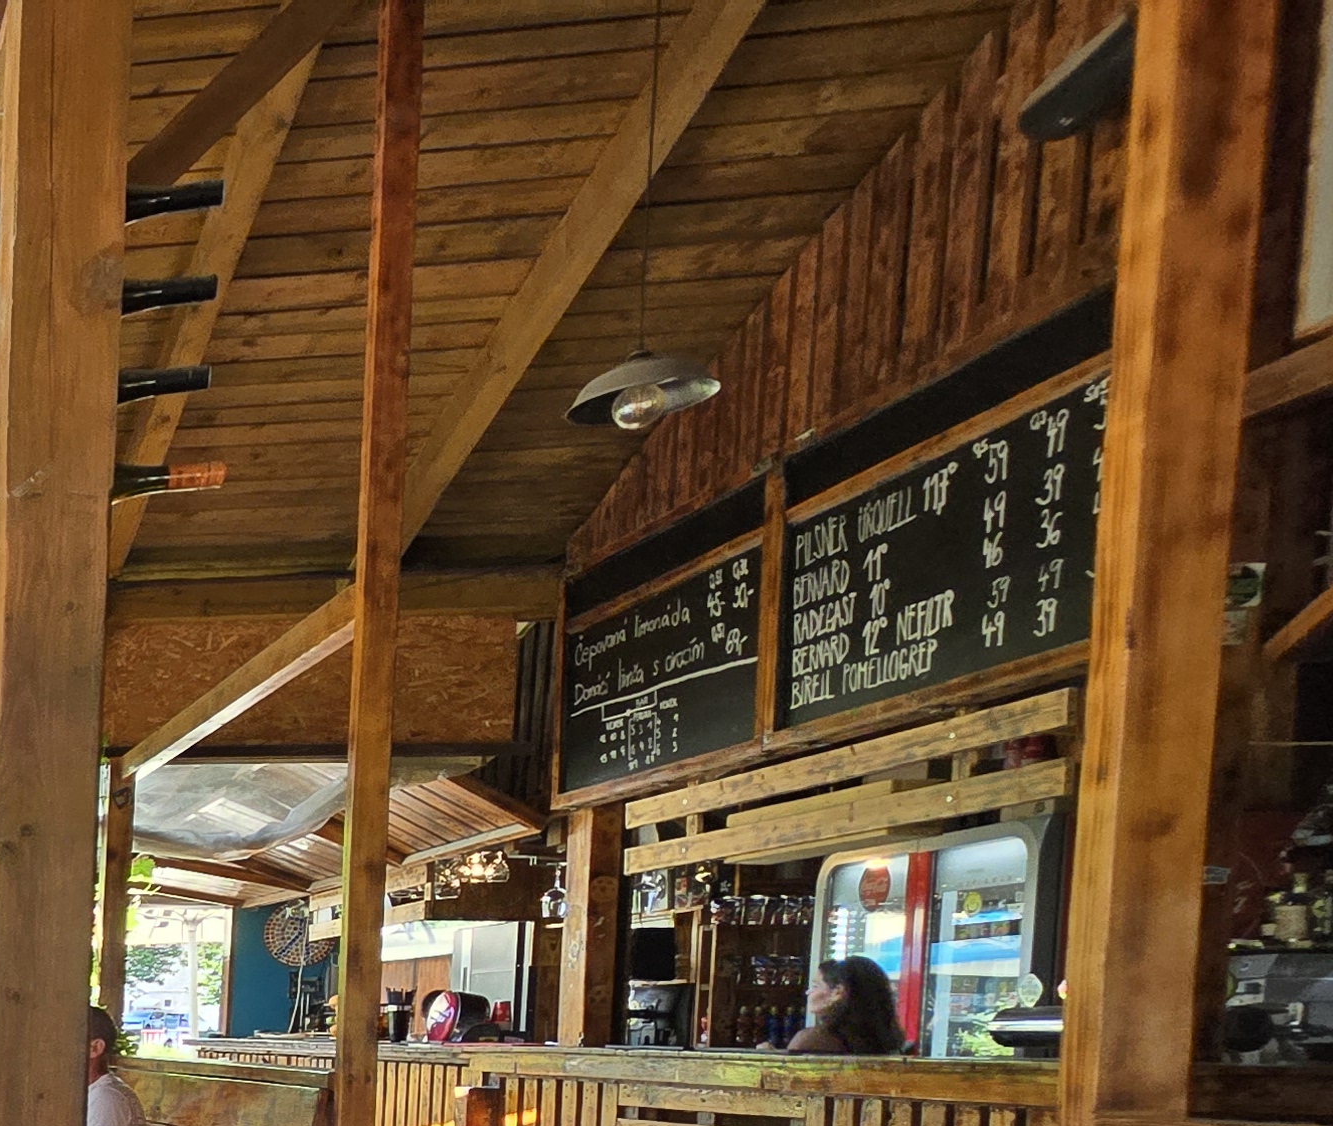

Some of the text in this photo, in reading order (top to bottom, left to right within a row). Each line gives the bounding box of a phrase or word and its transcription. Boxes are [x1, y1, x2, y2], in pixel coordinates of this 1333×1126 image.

[793, 559, 850, 611] BERNARD
[983, 490, 1007, 534] 49
[1034, 463, 1065, 506] 39
[795, 514, 849, 570] PILSNER
[984, 439, 1008, 484] 59
[1046, 408, 1069, 458] 49
[792, 632, 850, 678] BERNARD
[862, 616, 889, 657] 12°
[986, 575, 1012, 608] 59
[1037, 558, 1064, 592] 49
[793, 591, 858, 646] RADEGAST
[1035, 508, 1064, 548] 36
[790, 669, 835, 710] BIRELL
[981, 610, 1006, 648] 49
[1033, 597, 1058, 637] 39
